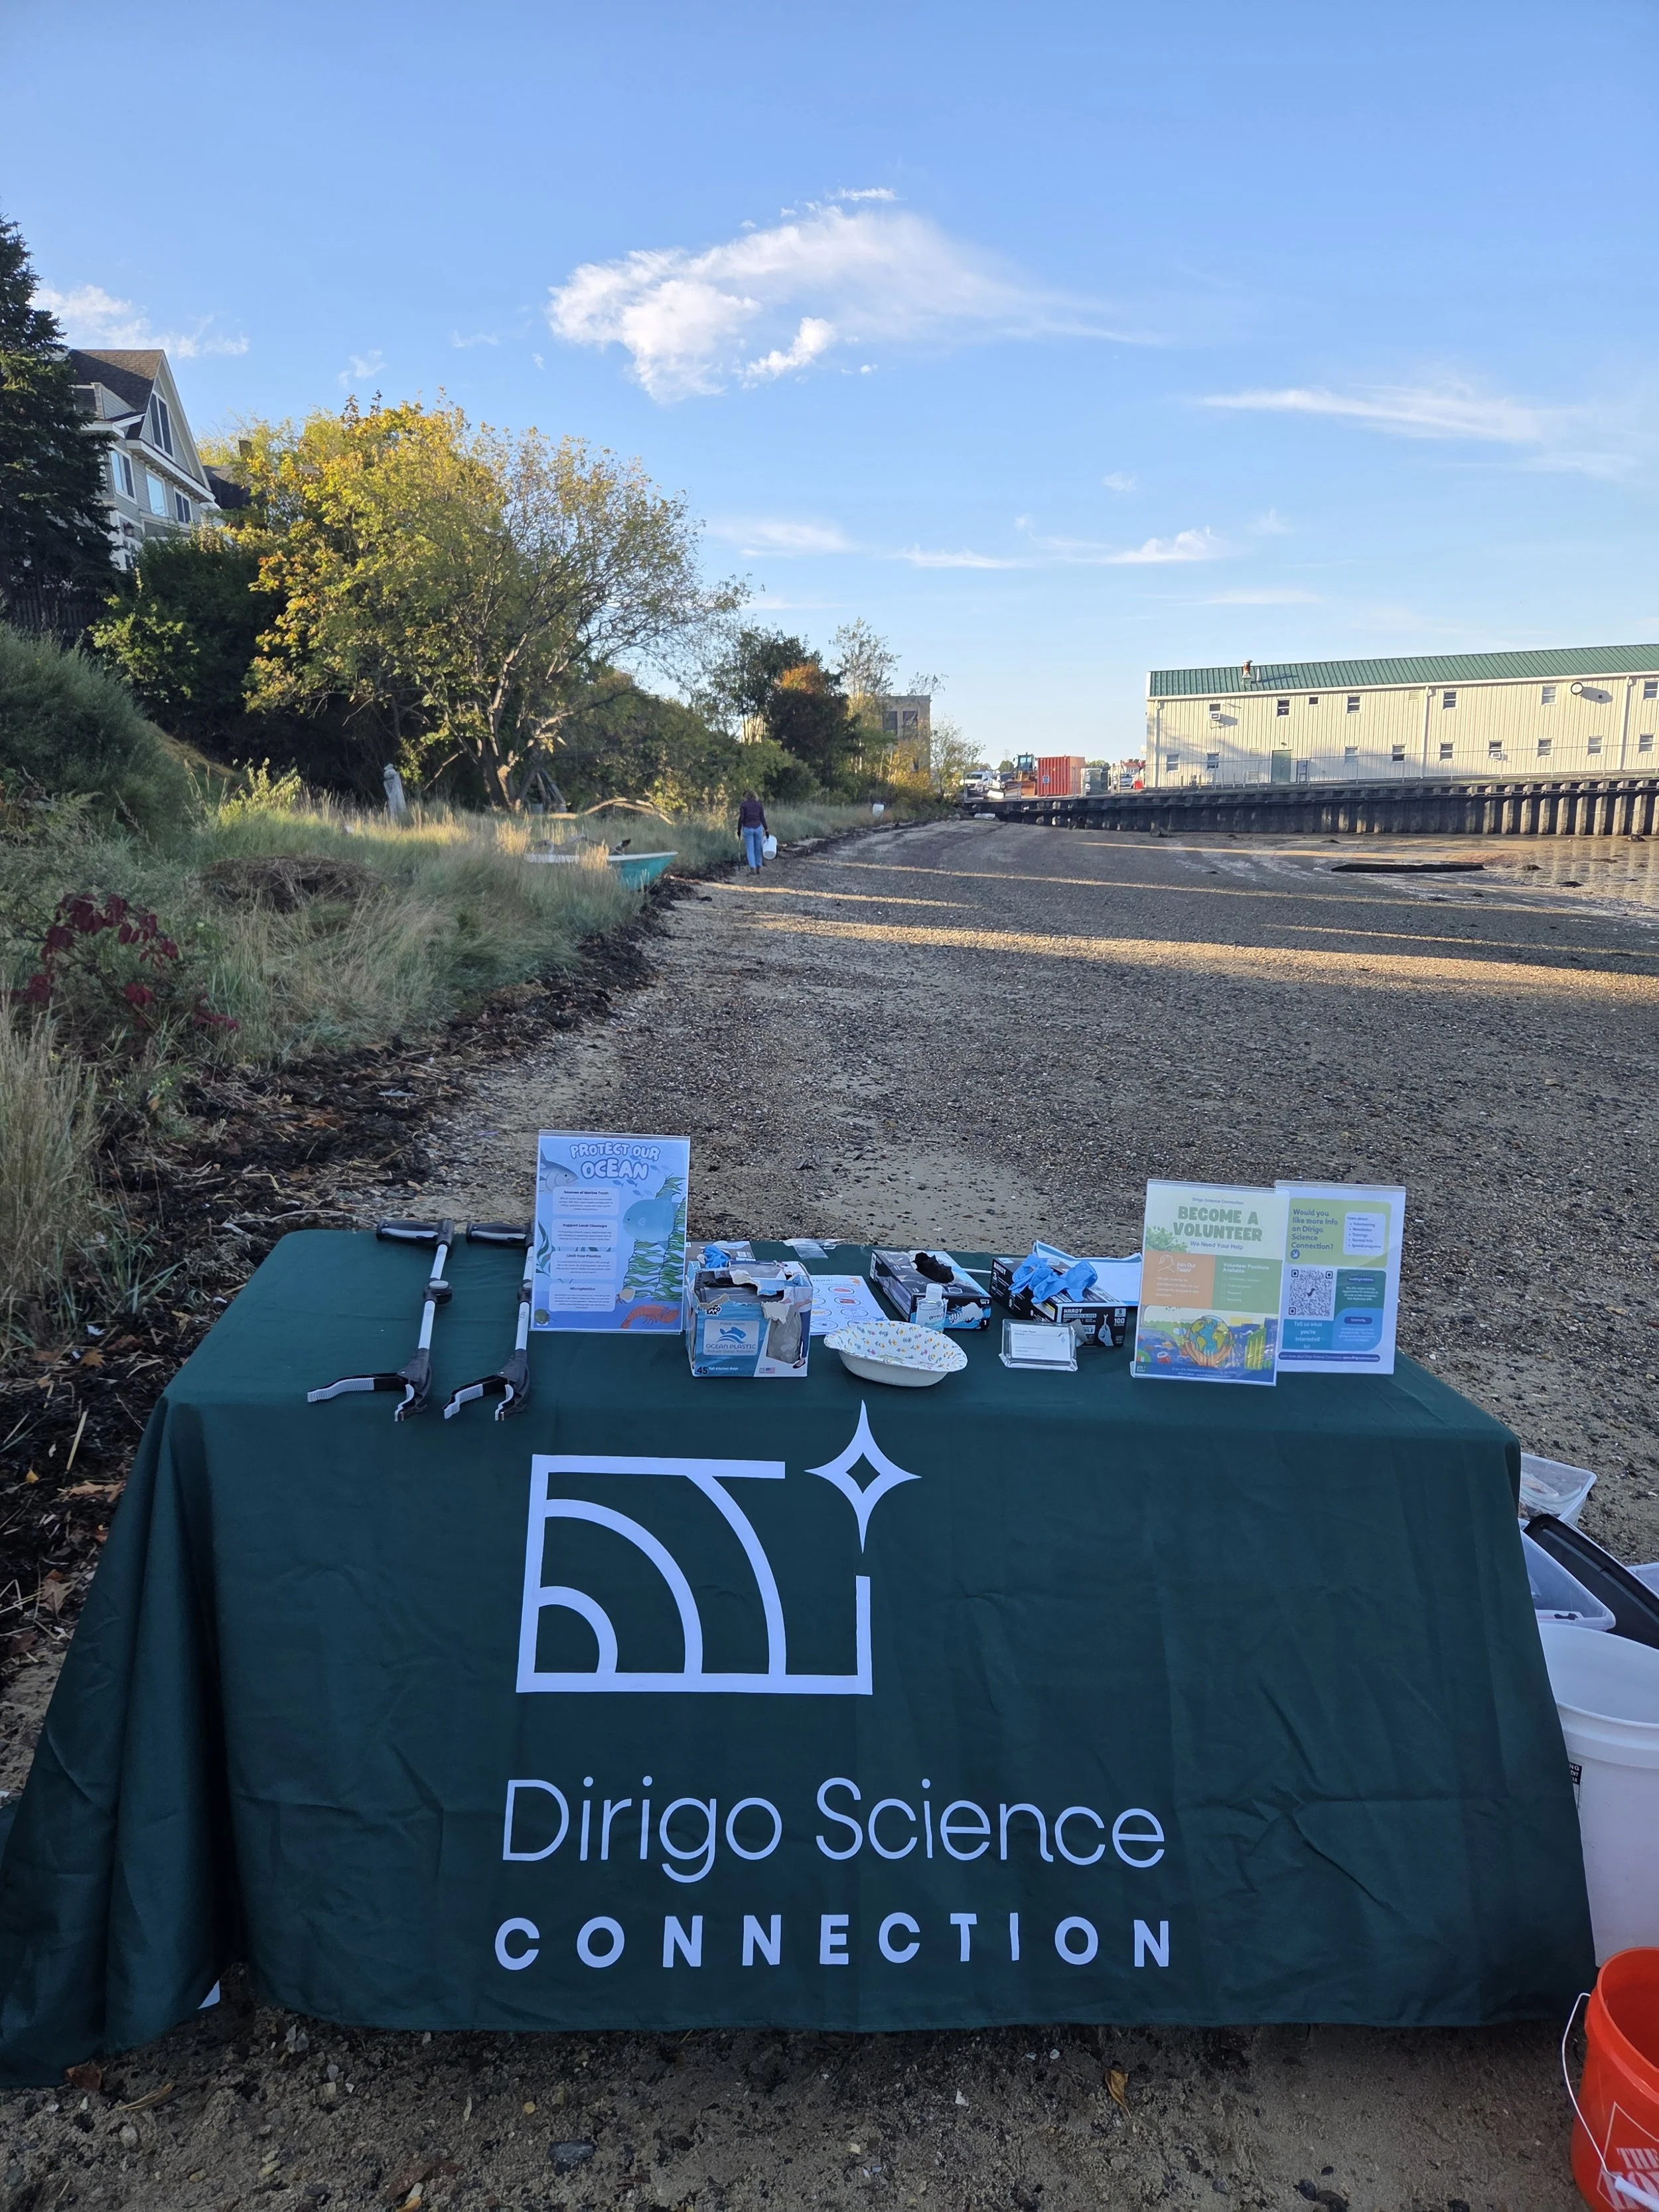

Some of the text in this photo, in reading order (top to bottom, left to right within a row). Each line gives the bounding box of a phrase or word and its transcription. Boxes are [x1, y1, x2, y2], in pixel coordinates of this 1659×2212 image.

[570, 1142, 660, 1161] PROTECT OUR
[581, 1157, 648, 1180] OCEAN
[1178, 1206, 1259, 1225] BECOME A
[1173, 1222, 1263, 1242] VOLUNTEER
[502, 1776, 1165, 1883] Dirigo Science
[494, 1912, 1169, 1970] CONNECTION
[1616, 2147, 1659, 2170] THE
